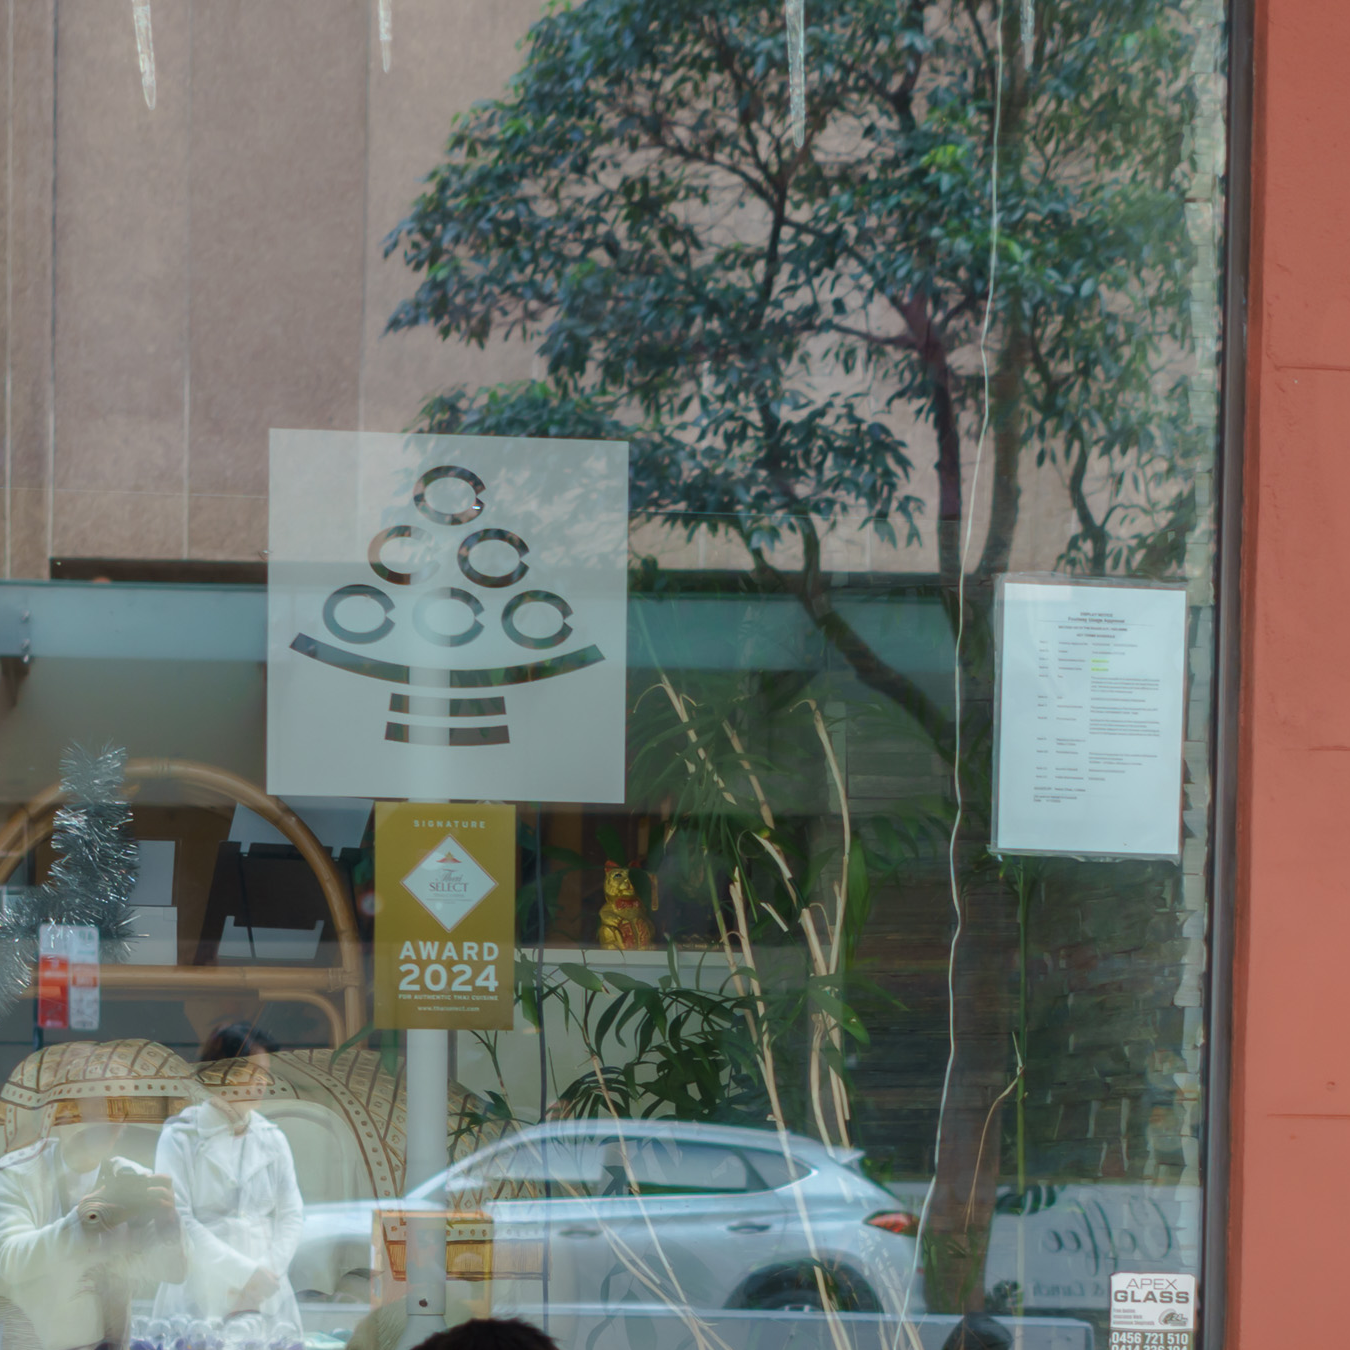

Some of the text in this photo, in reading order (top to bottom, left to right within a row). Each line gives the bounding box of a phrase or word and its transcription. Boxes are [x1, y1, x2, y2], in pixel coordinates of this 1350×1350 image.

[413, 819, 487, 829] SIGNATURE
[429, 881, 470, 893] SELECT
[399, 940, 499, 961] AWARD
[398, 963, 499, 992] 2024
[1125, 1278, 1178, 1290] APEX
[1113, 1290, 1190, 1304] GLASS
[1111, 1332, 1189, 1345] 0456 721 510
